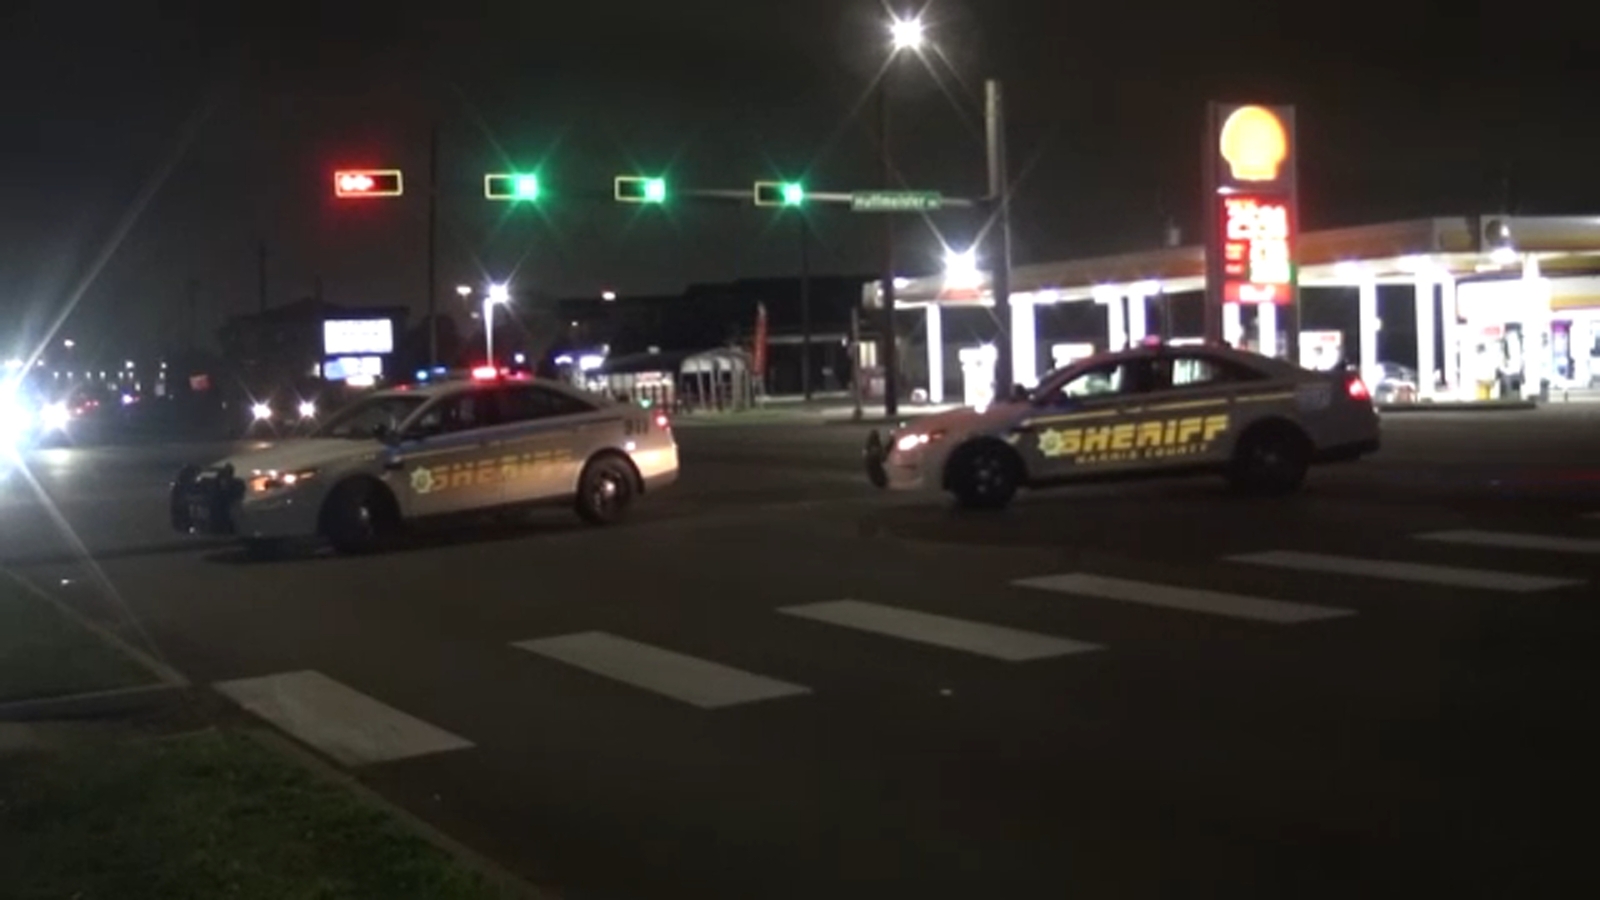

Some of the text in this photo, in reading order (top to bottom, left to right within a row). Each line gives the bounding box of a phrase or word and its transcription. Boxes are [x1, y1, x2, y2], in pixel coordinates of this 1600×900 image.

[1058, 415, 1228, 455] SHERIFF
[1075, 444, 1207, 465] HARRIS COUNTY
[432, 449, 573, 490] SHERIFF
